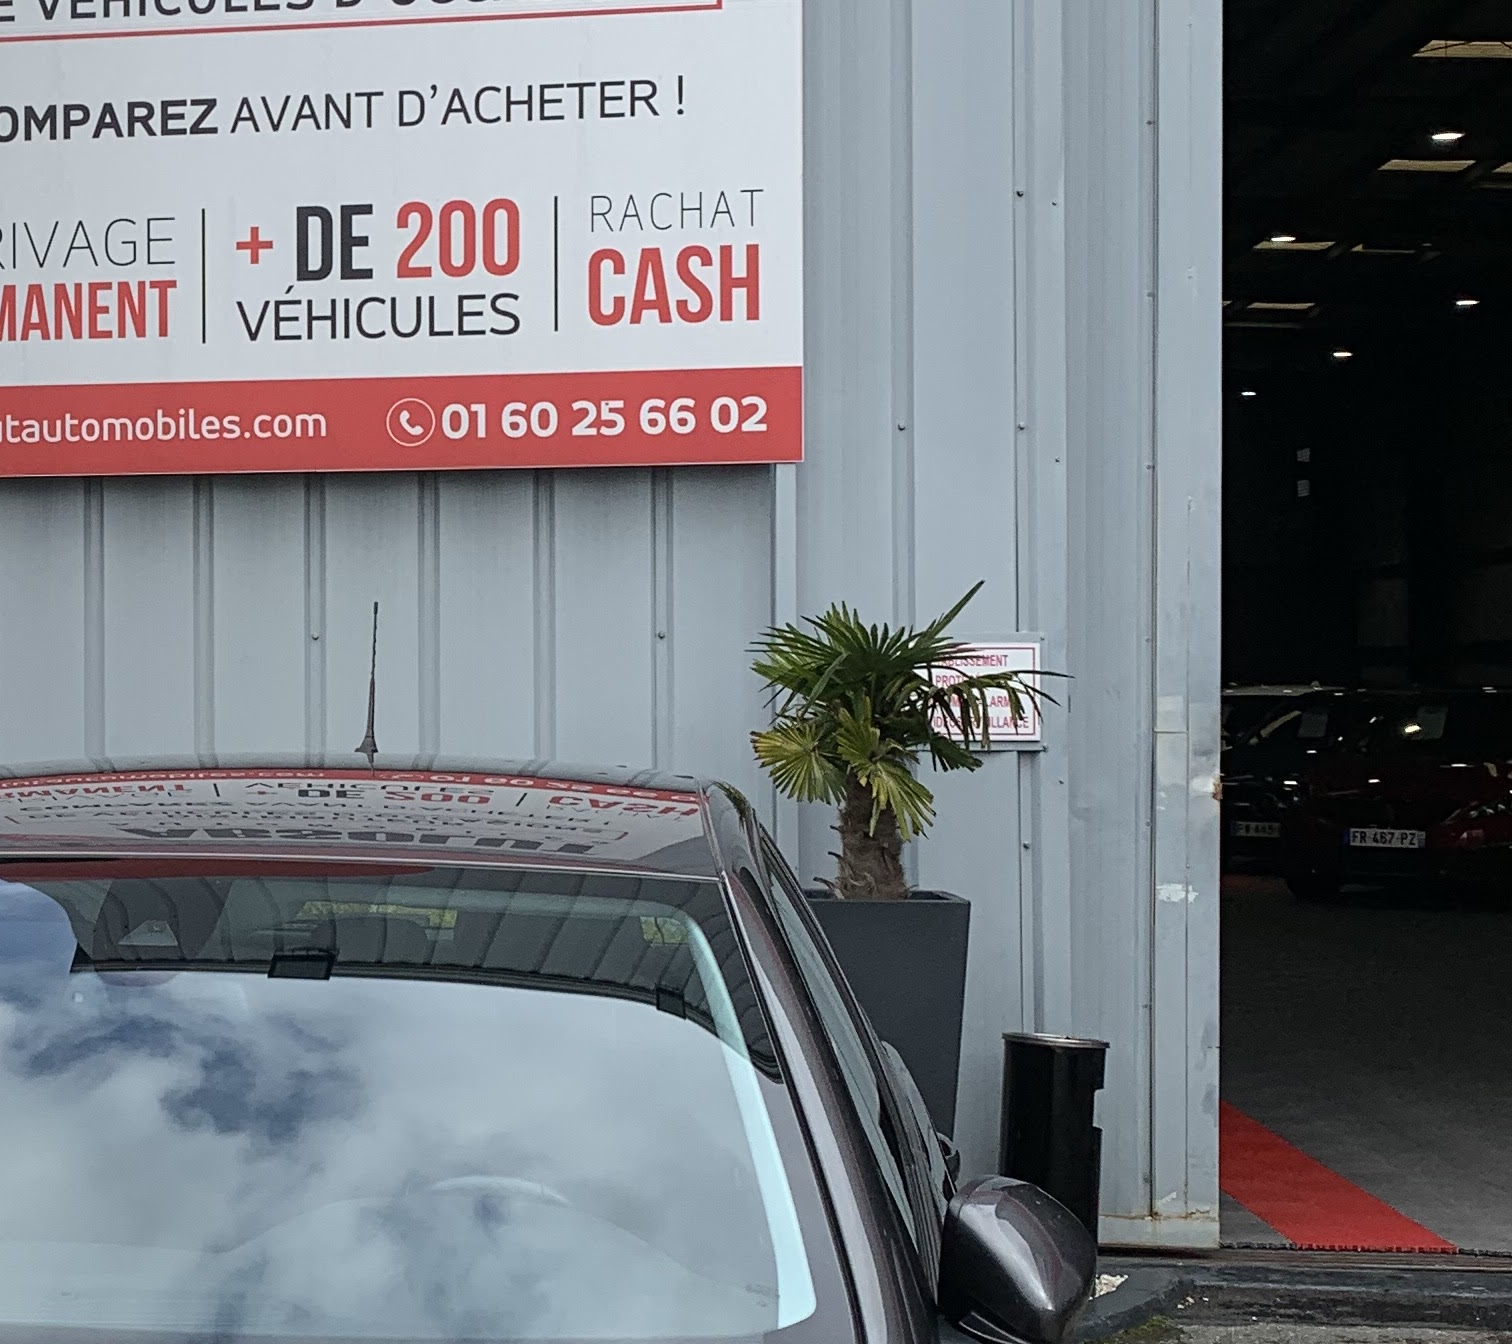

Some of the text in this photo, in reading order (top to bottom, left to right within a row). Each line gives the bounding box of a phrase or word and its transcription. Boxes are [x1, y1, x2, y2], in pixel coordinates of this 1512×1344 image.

[230, 91, 384, 133] AVANT
[399, 80, 659, 127] D'ACHETER
[590, 188, 765, 232] RACHAT
[236, 198, 520, 281] + DE 200
[588, 244, 760, 325] CASH
[236, 285, 520, 341] VÉHICULES
[441, 396, 768, 439] 01 60 25 66 02
